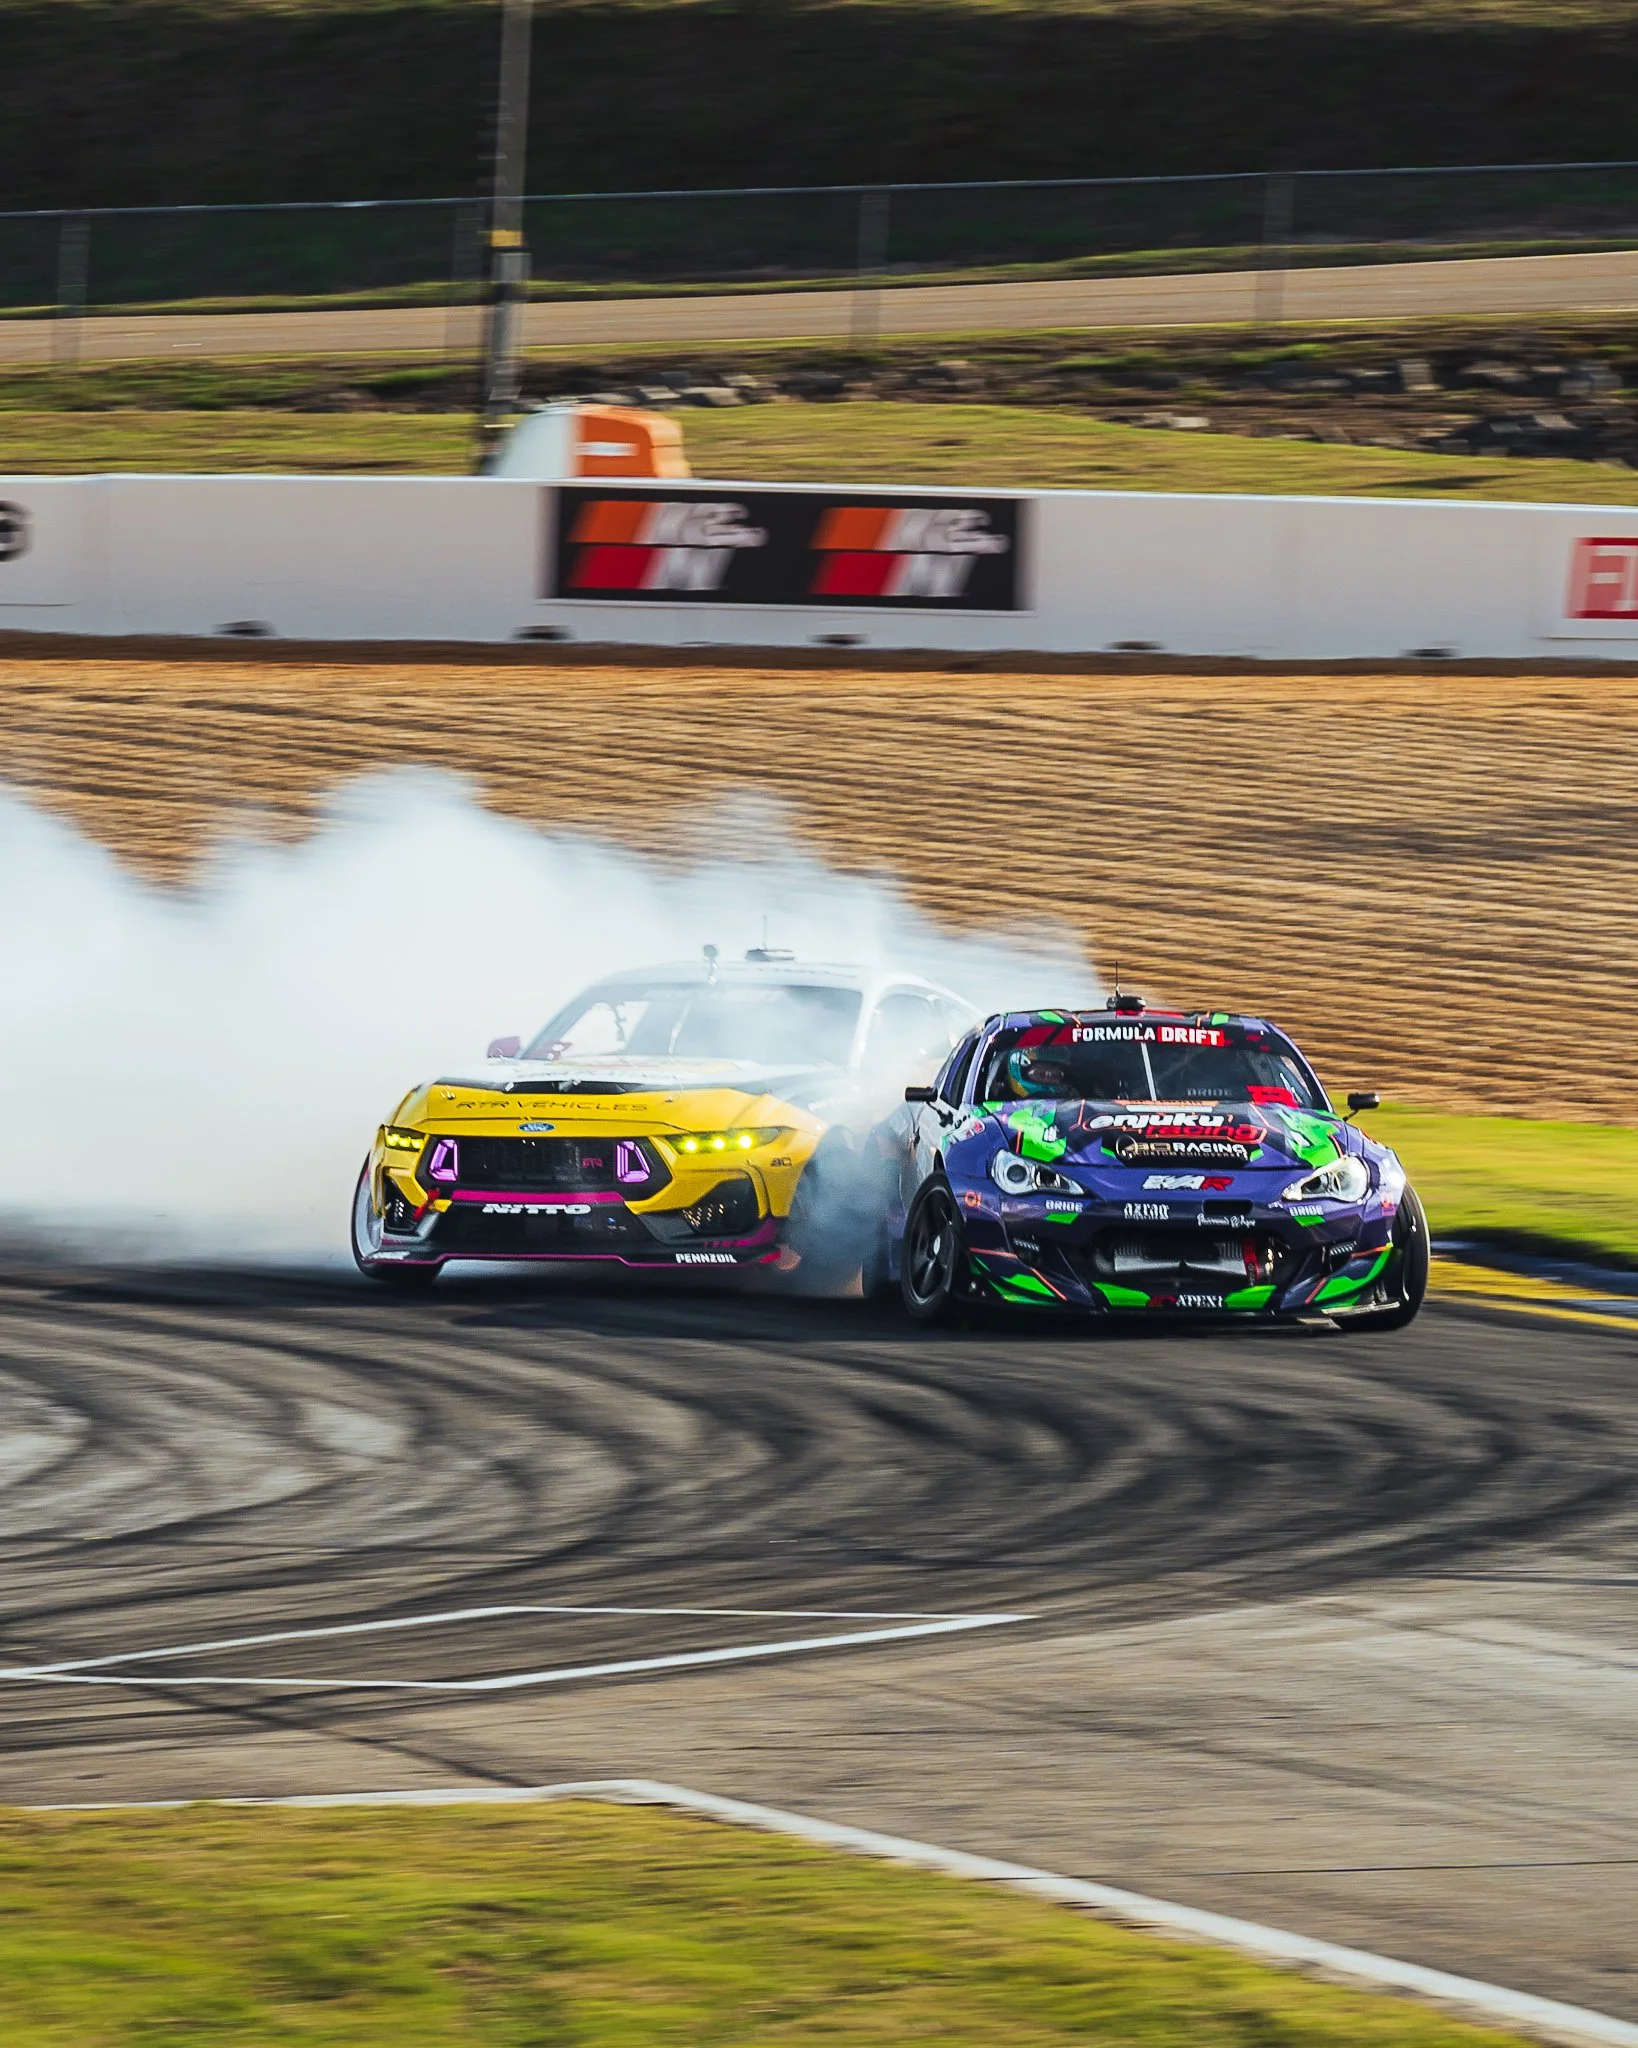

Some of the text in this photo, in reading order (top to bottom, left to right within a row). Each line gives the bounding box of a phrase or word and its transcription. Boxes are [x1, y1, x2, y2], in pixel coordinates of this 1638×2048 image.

[1072, 1026, 1220, 1046] FORMULA DRIFT
[517, 1101, 648, 1111] VEHICLES
[1090, 1114, 1224, 1129] enjuku
[1146, 1124, 1258, 1141] racing
[1173, 1142, 1247, 1156] RACING
[482, 1203, 592, 1215] NITTO
[1045, 1199, 1083, 1213] BRIDE
[675, 1253, 737, 1264] PENNZOIL
